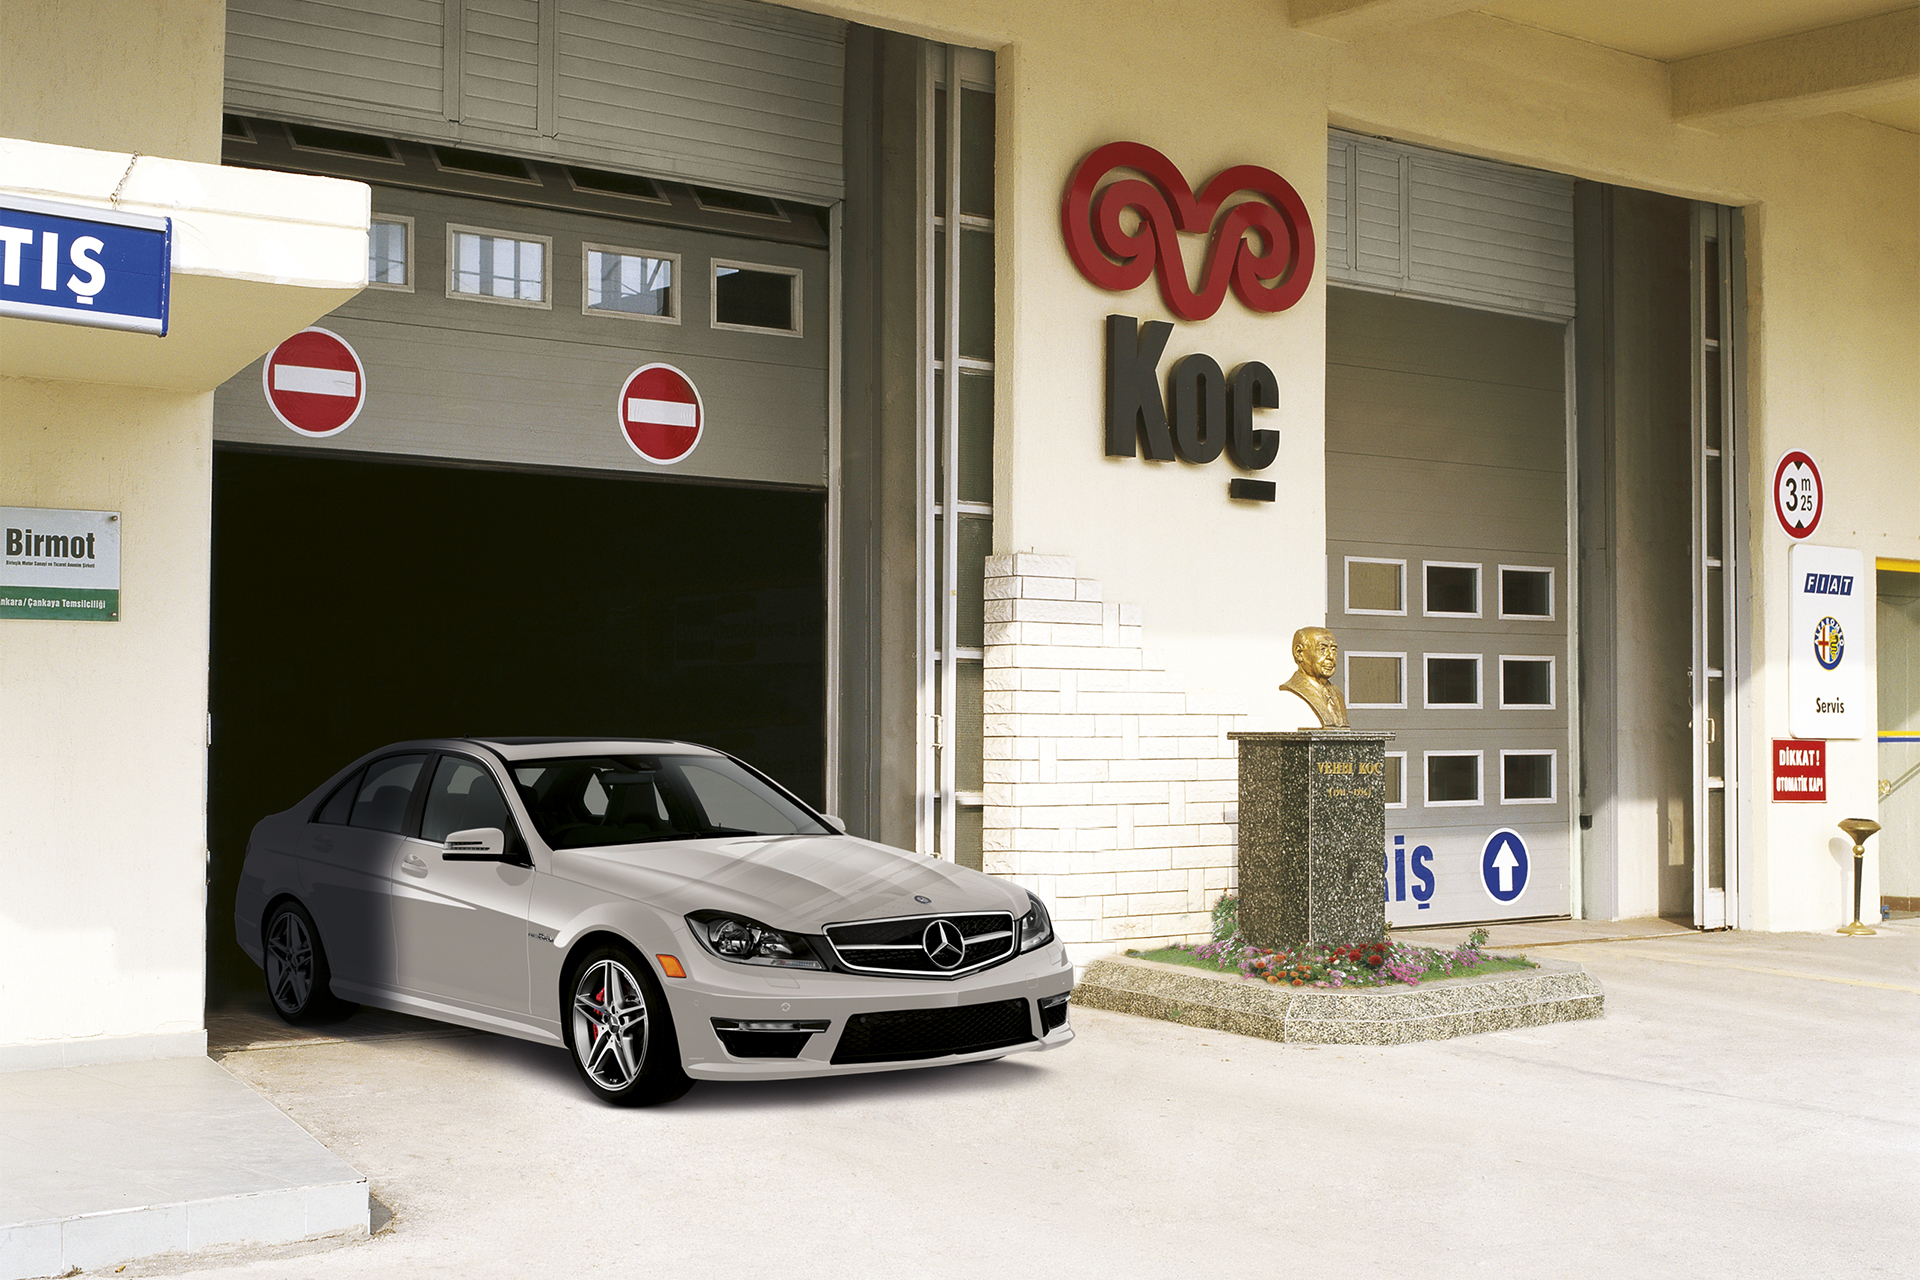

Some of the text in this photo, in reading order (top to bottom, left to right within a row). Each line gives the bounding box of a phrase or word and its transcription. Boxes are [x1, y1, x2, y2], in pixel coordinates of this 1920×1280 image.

[0, 225, 106, 305] TIŞ
[1104, 313, 1281, 503] Koç
[1785, 477, 1812, 512] 3 m
[1800, 494, 1813, 512] 25
[6, 528, 95, 559] Birmot
[1807, 576, 1851, 594] FIAT
[62, 599, 106, 609] Temsilciliği
[1816, 697, 1845, 714] Servis
[1316, 756, 1353, 775] VEHBİ
[1776, 775, 1823, 792] OTOMATİK KAPI
[1384, 835, 1436, 910] İŞ
